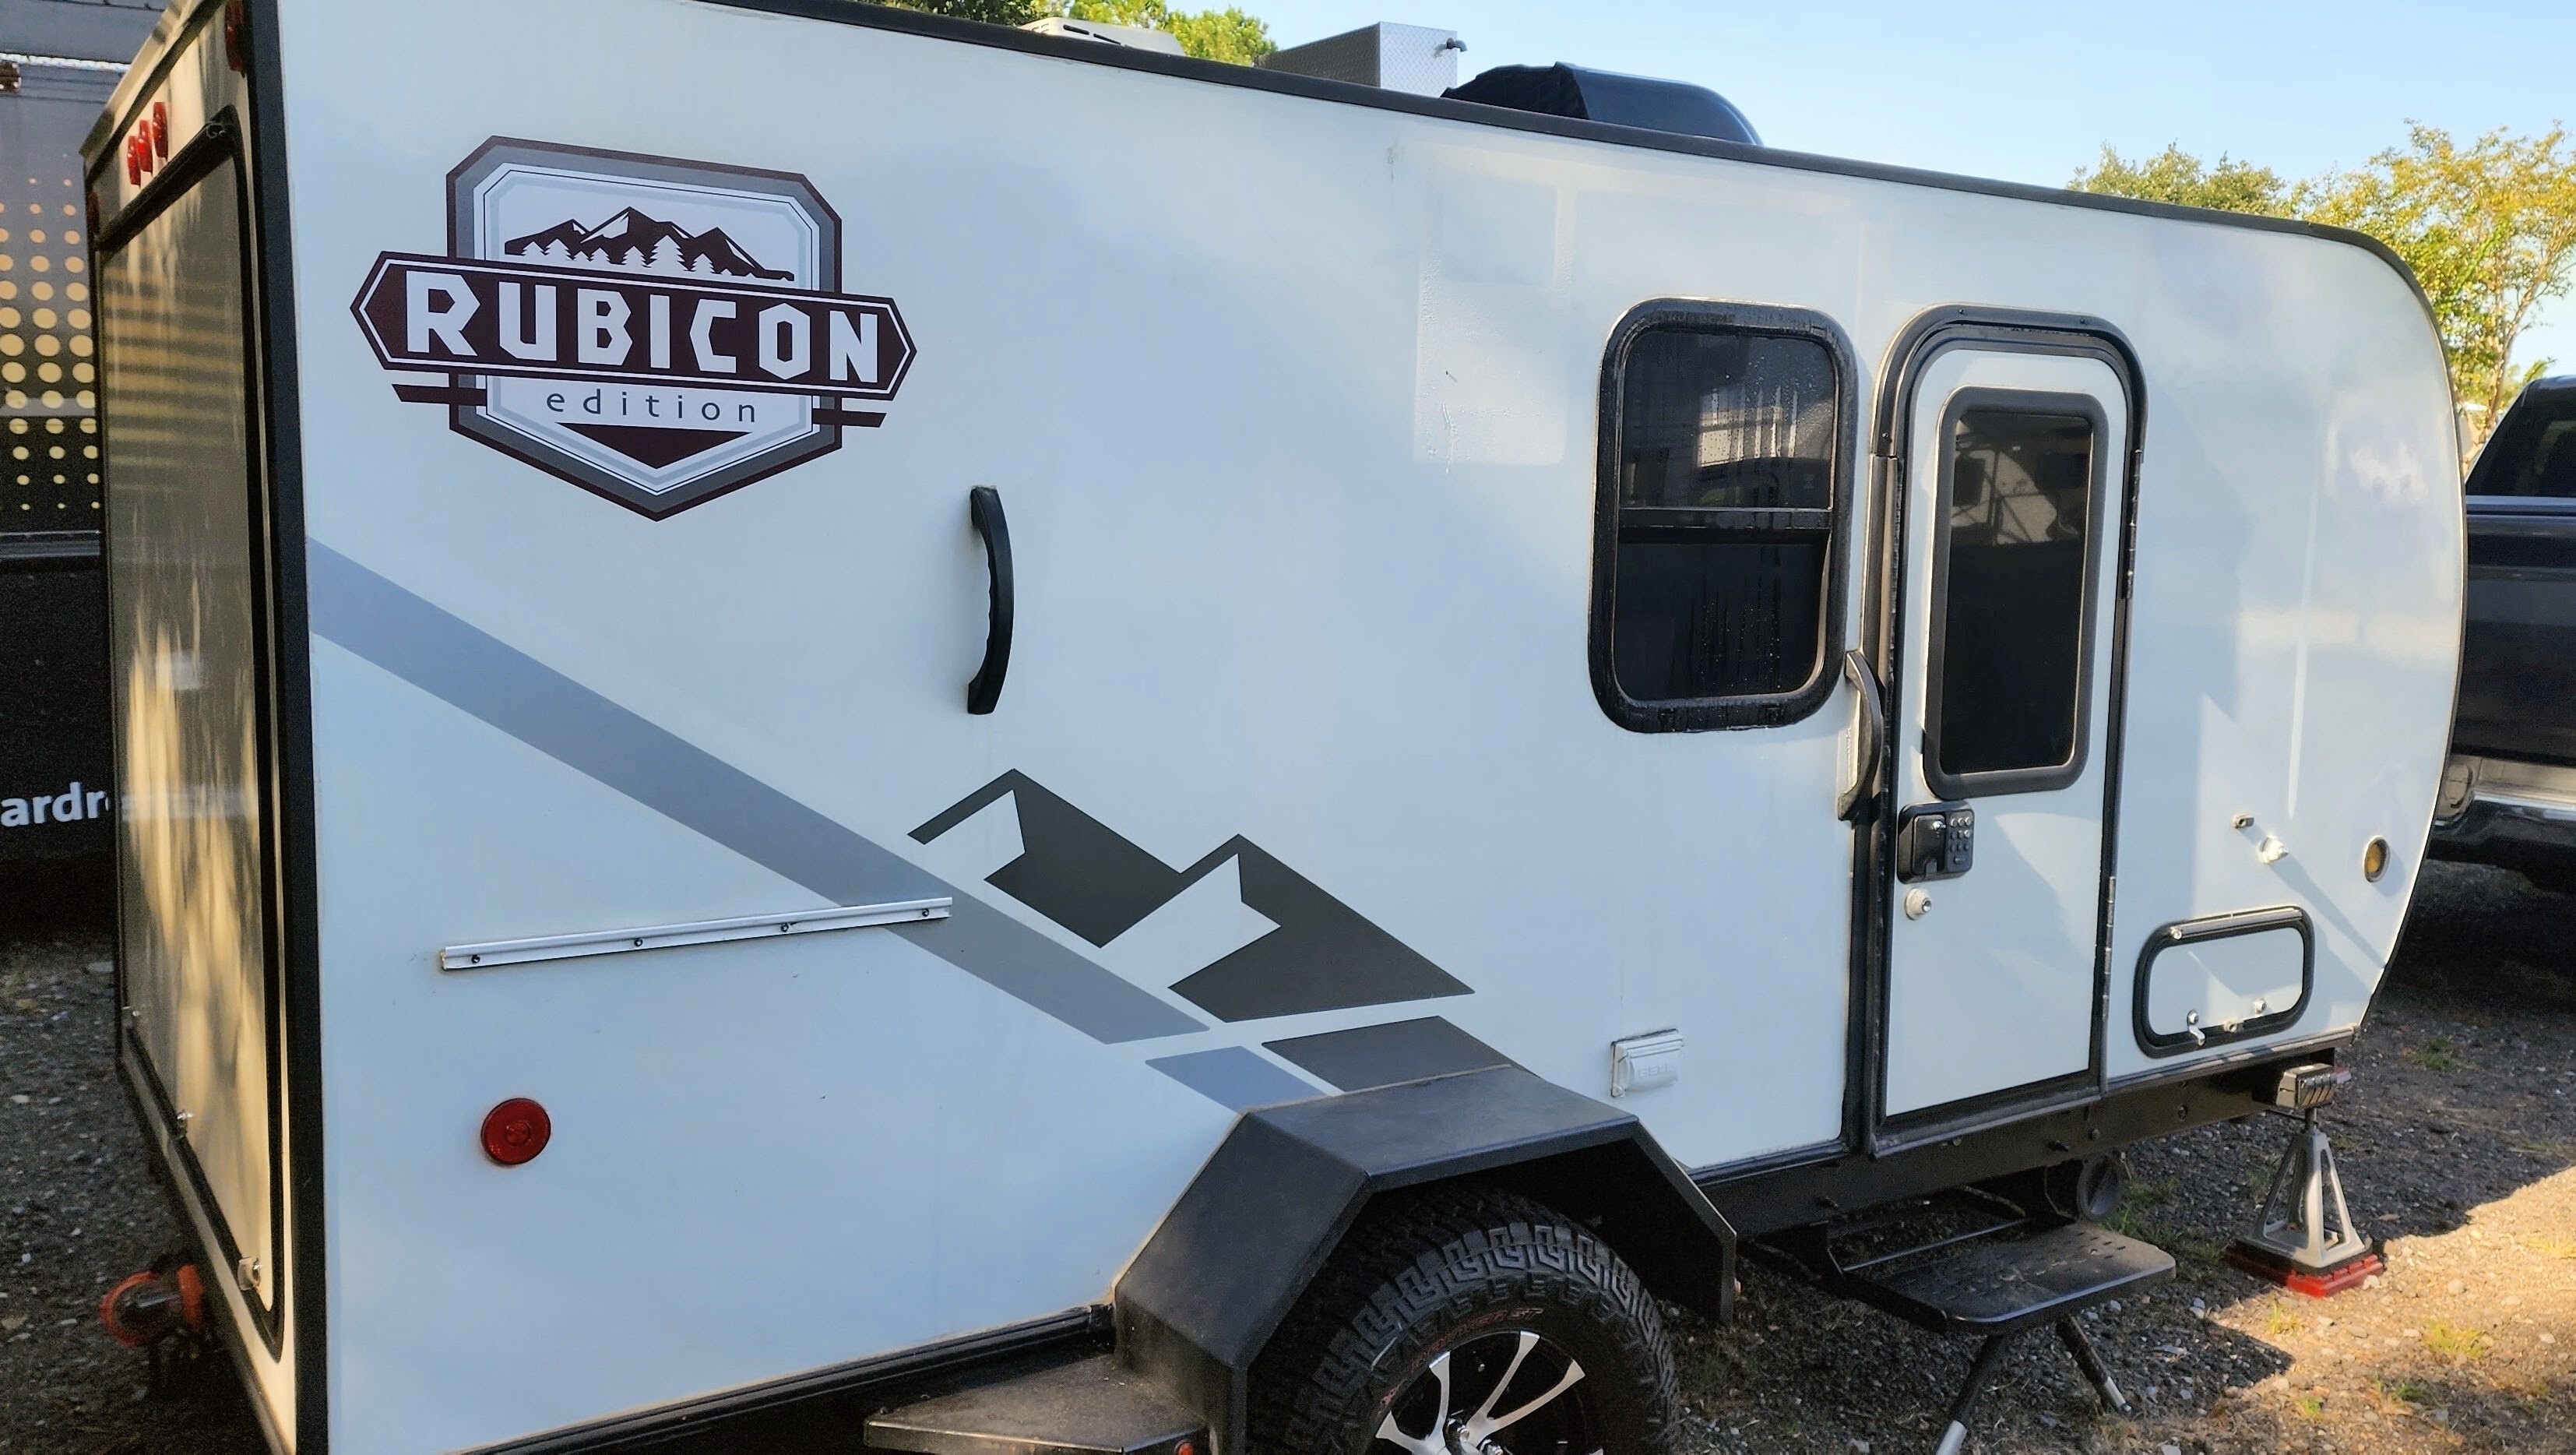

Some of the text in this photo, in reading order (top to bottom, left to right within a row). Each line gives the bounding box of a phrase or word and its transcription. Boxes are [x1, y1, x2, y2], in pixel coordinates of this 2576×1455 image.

[405, 270, 878, 384] RUBICON
[546, 389, 755, 423] edition
[0, 781, 109, 827] ardr
